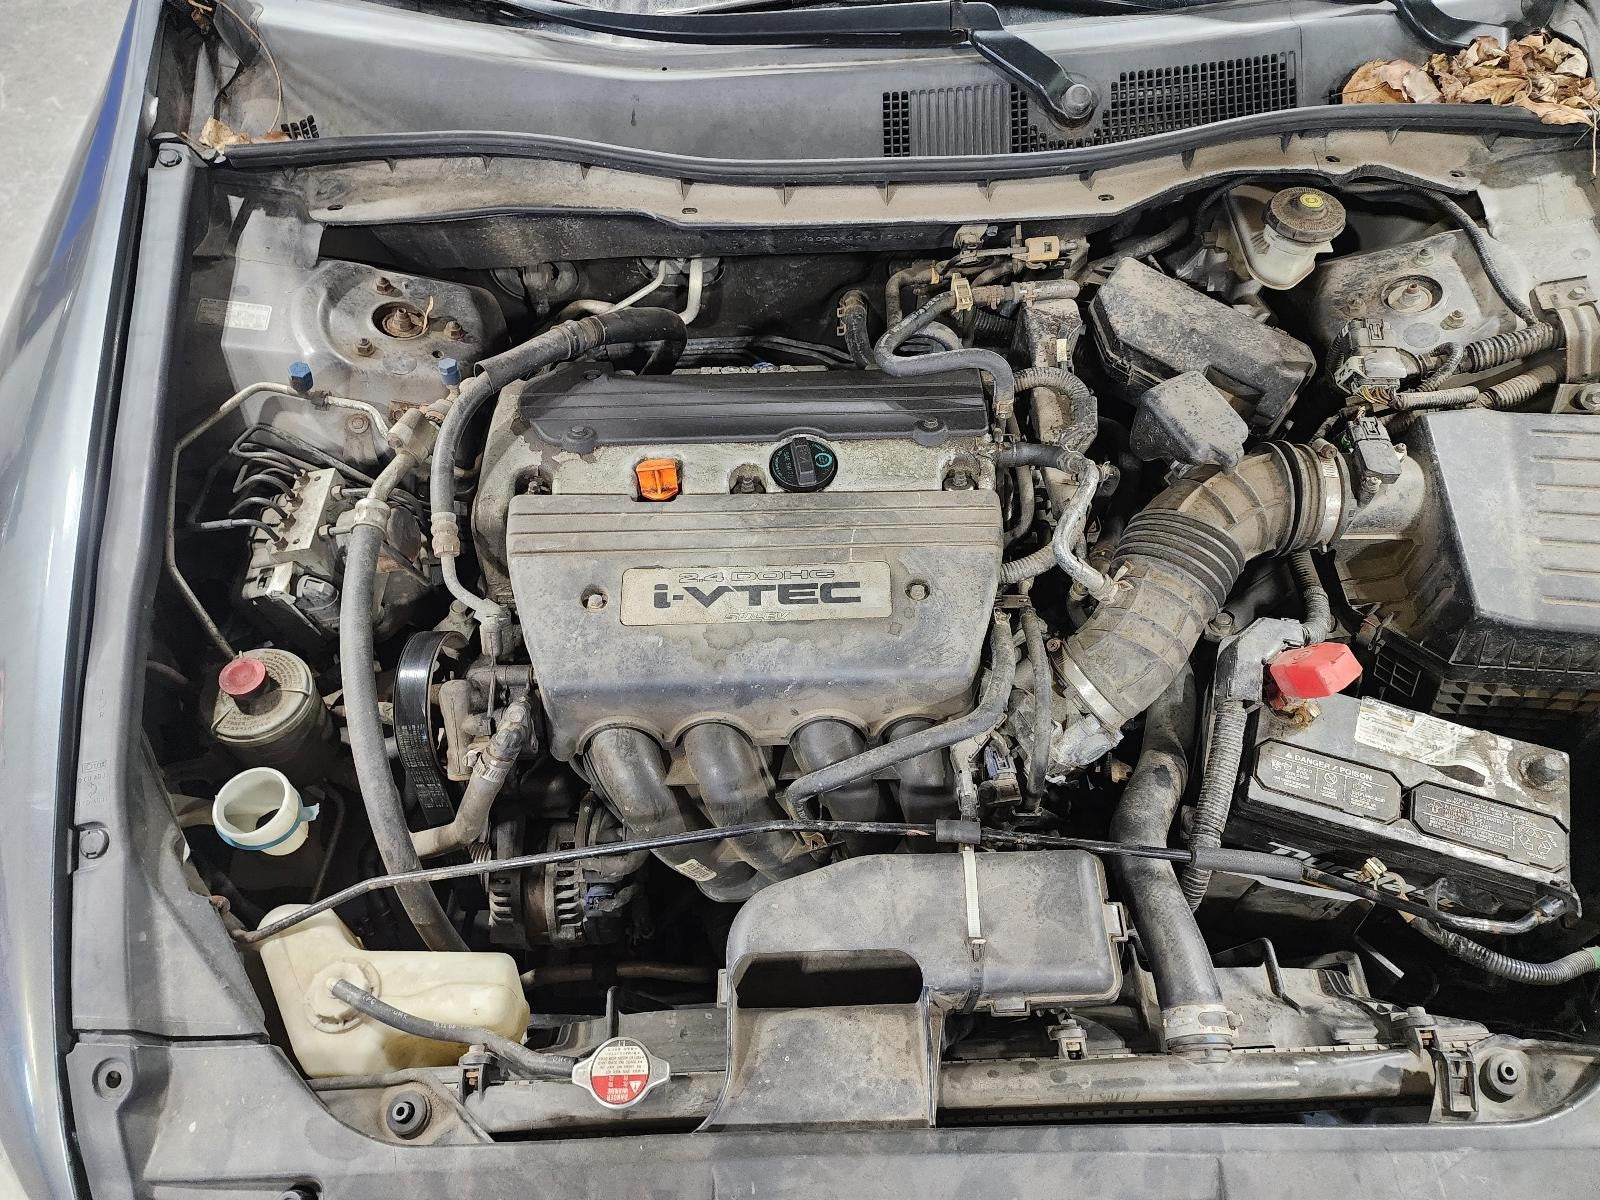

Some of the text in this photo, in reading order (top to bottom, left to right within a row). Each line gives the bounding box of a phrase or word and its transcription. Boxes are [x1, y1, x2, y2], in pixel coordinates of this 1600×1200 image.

[678, 569, 835, 584] 2.4 DOHC
[653, 581, 862, 609] i-VTEC
[1294, 755, 1331, 769] DANGER
[1339, 767, 1373, 781] POISON
